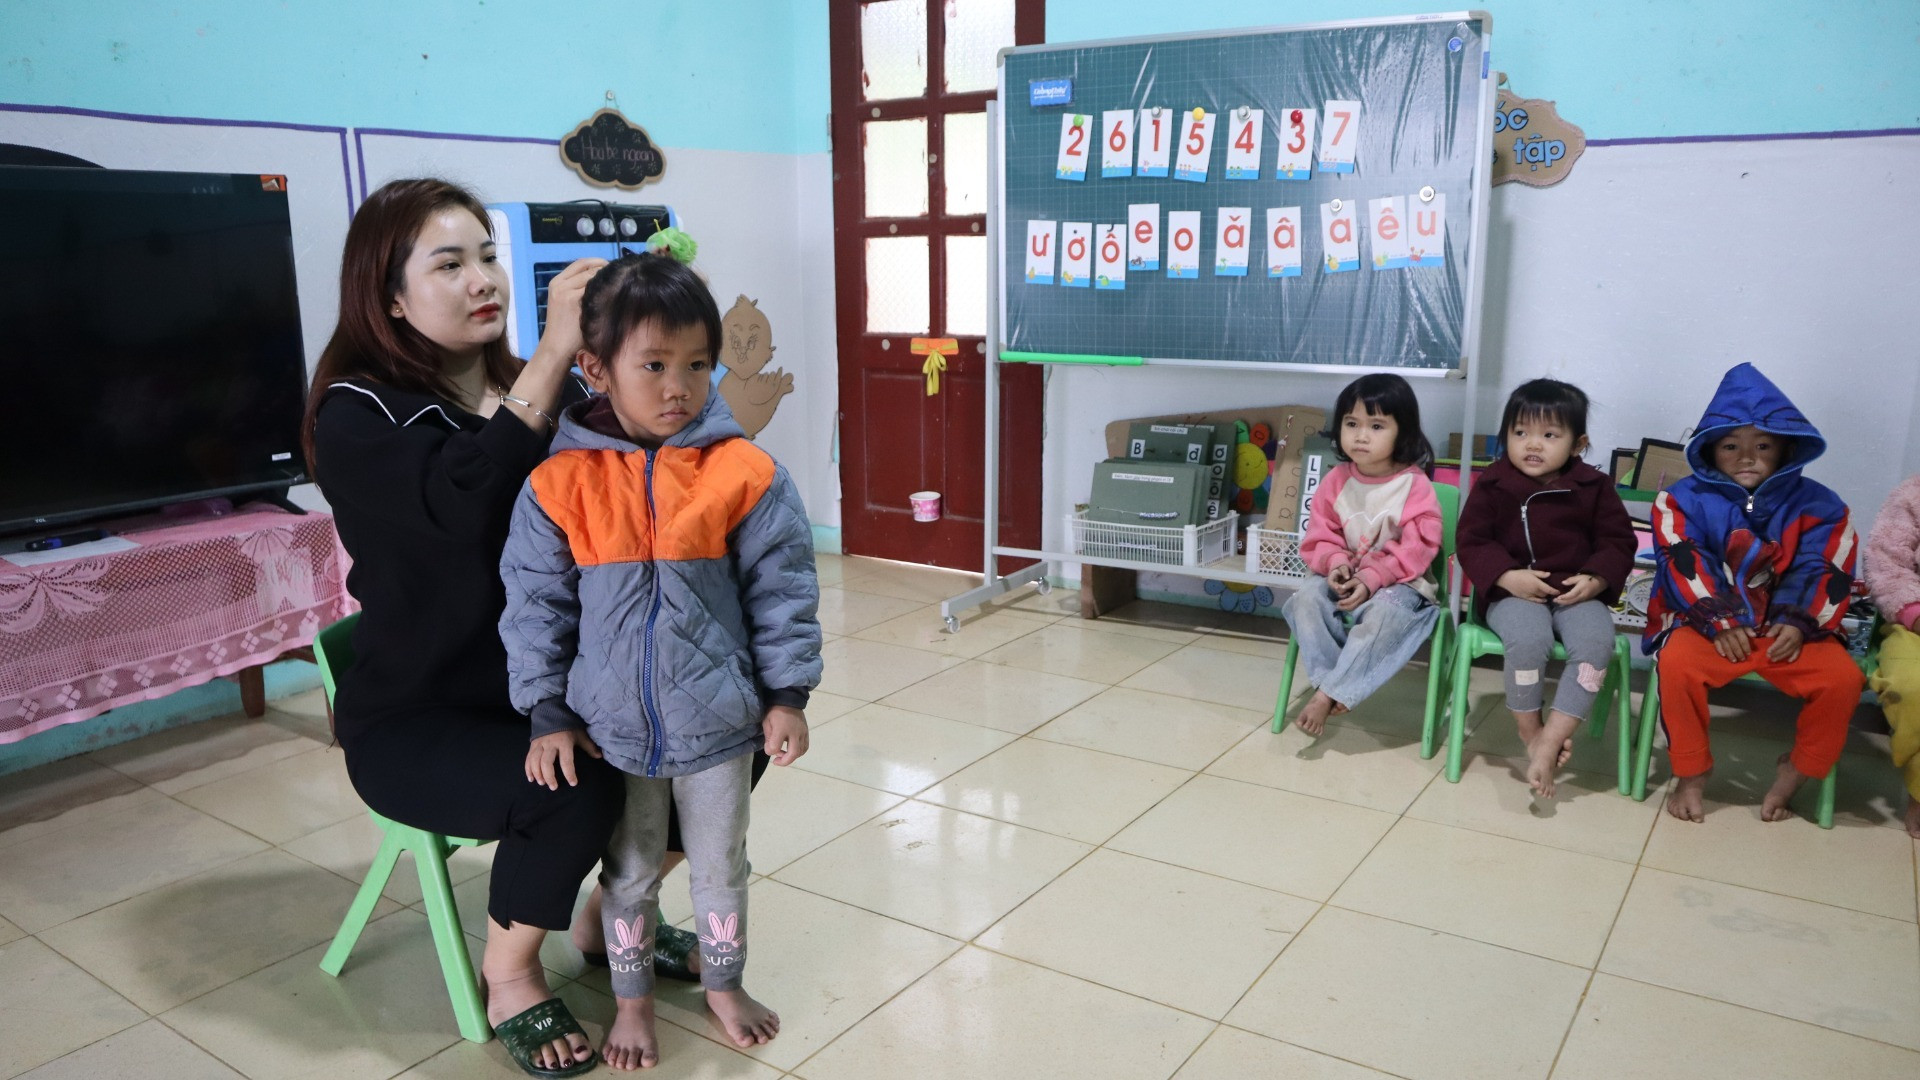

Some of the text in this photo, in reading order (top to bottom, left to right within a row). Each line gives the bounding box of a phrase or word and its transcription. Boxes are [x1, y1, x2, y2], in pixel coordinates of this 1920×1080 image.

[1495, 101, 1529, 133] óc
[1066, 111, 1351, 156] 2 6 1 5 4 3 7
[1513, 133, 1566, 171] tập
[1032, 206, 1437, 263] ư ơ ô e o ă â a ê u
[1133, 442, 1142, 455] B
[1310, 457, 1317, 472] L
[1307, 477, 1317, 491] P
[534, 1017, 553, 1031] VIP
